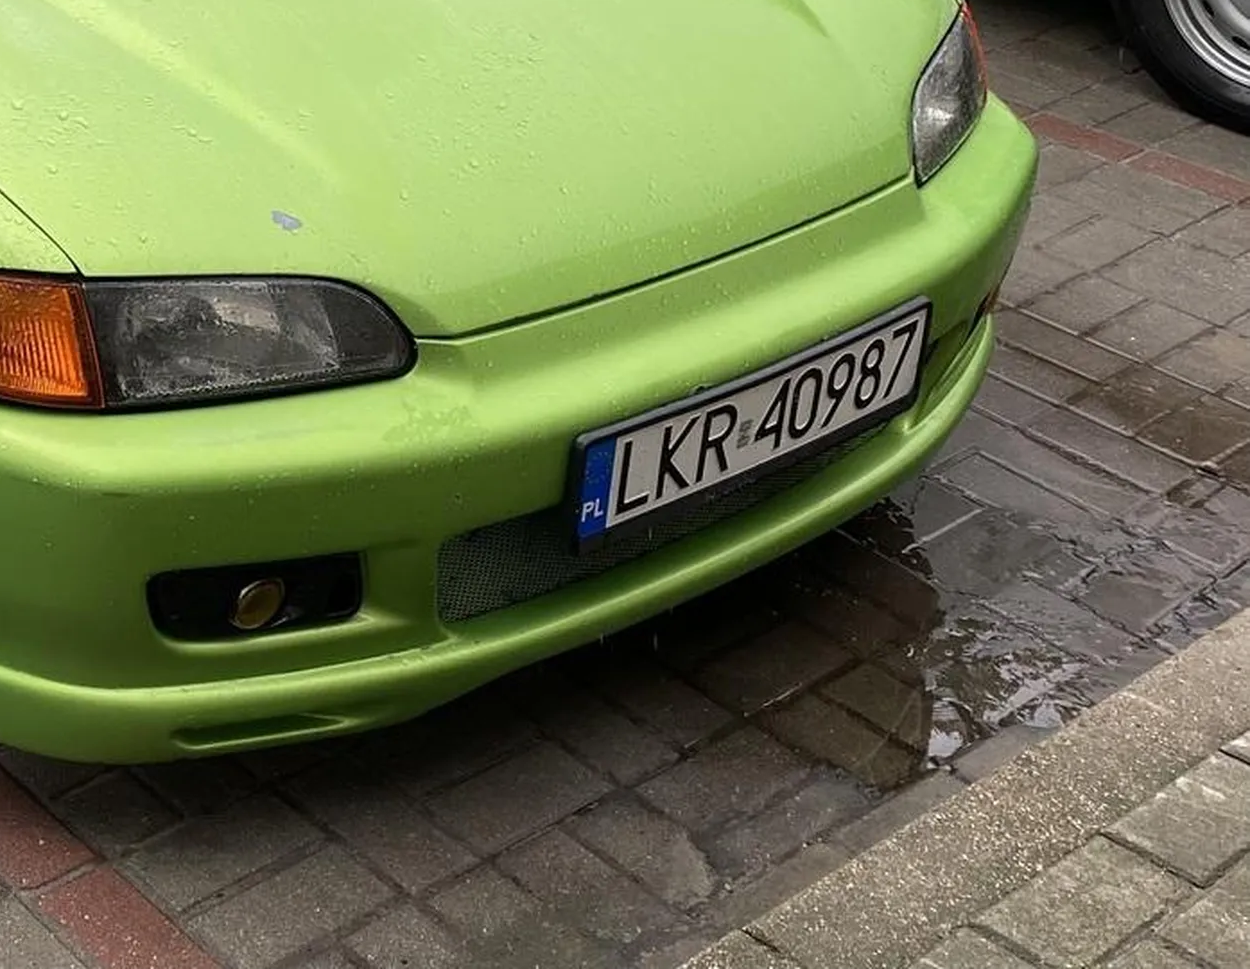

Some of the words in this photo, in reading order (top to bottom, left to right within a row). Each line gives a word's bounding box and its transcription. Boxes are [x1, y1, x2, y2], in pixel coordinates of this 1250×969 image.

[616, 404, 738, 516] LKR
[753, 318, 920, 451] 40987
[580, 499, 604, 523] PL
